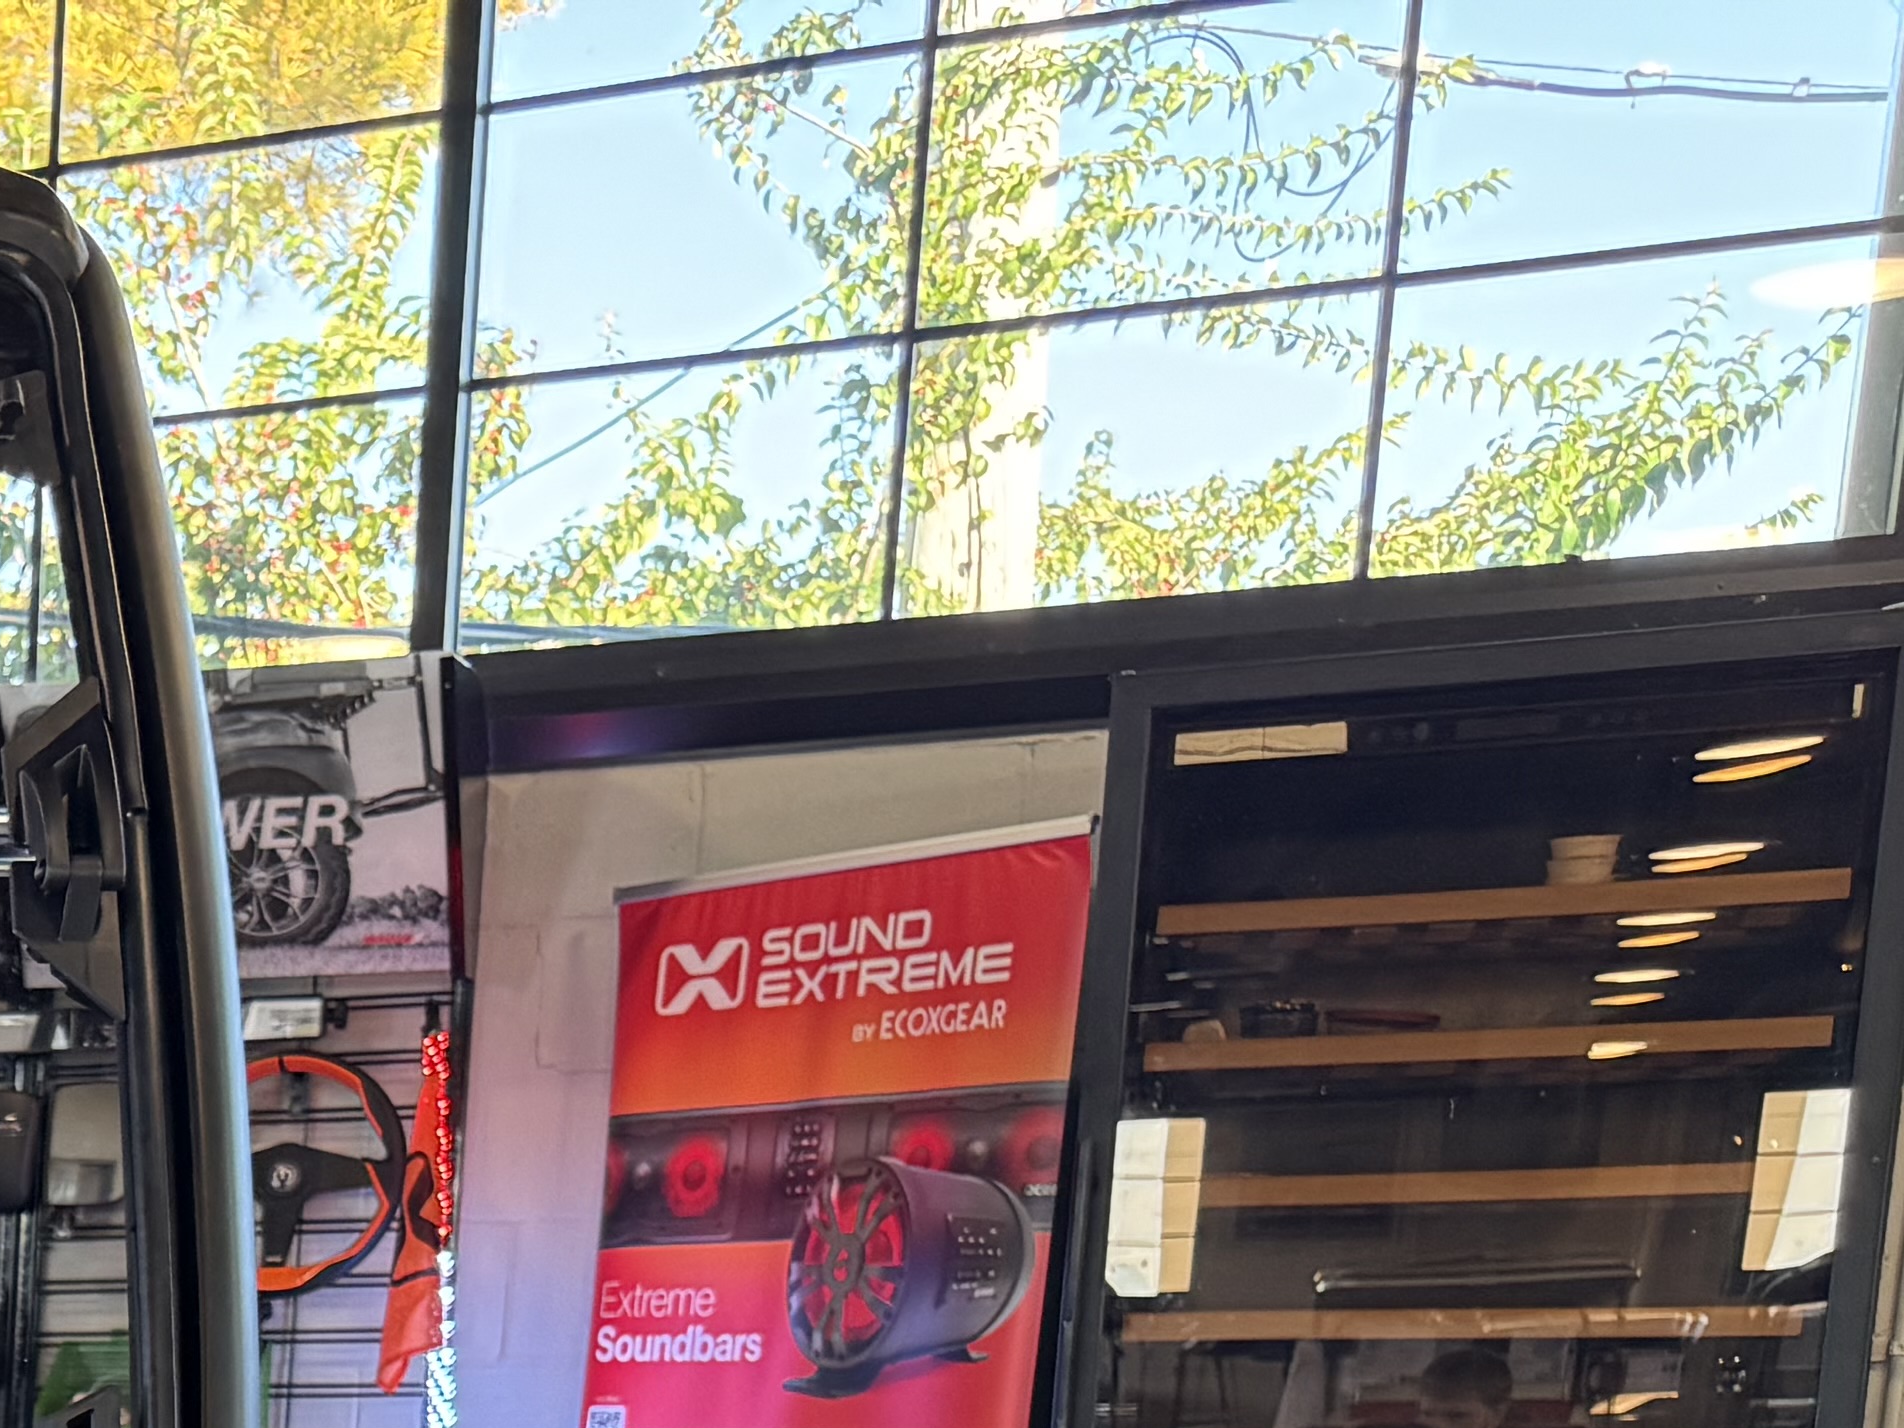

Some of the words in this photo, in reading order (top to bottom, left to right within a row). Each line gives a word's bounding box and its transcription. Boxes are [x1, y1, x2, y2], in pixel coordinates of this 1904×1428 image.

[222, 794, 350, 851] WER
[760, 909, 932, 967] SOUND
[755, 942, 1015, 1008] EXTREME
[852, 1023, 876, 1043] BY
[879, 999, 1007, 1041] ECOXGEAR
[599, 1279, 716, 1319] Extreme
[595, 1324, 763, 1363] Soundbars
